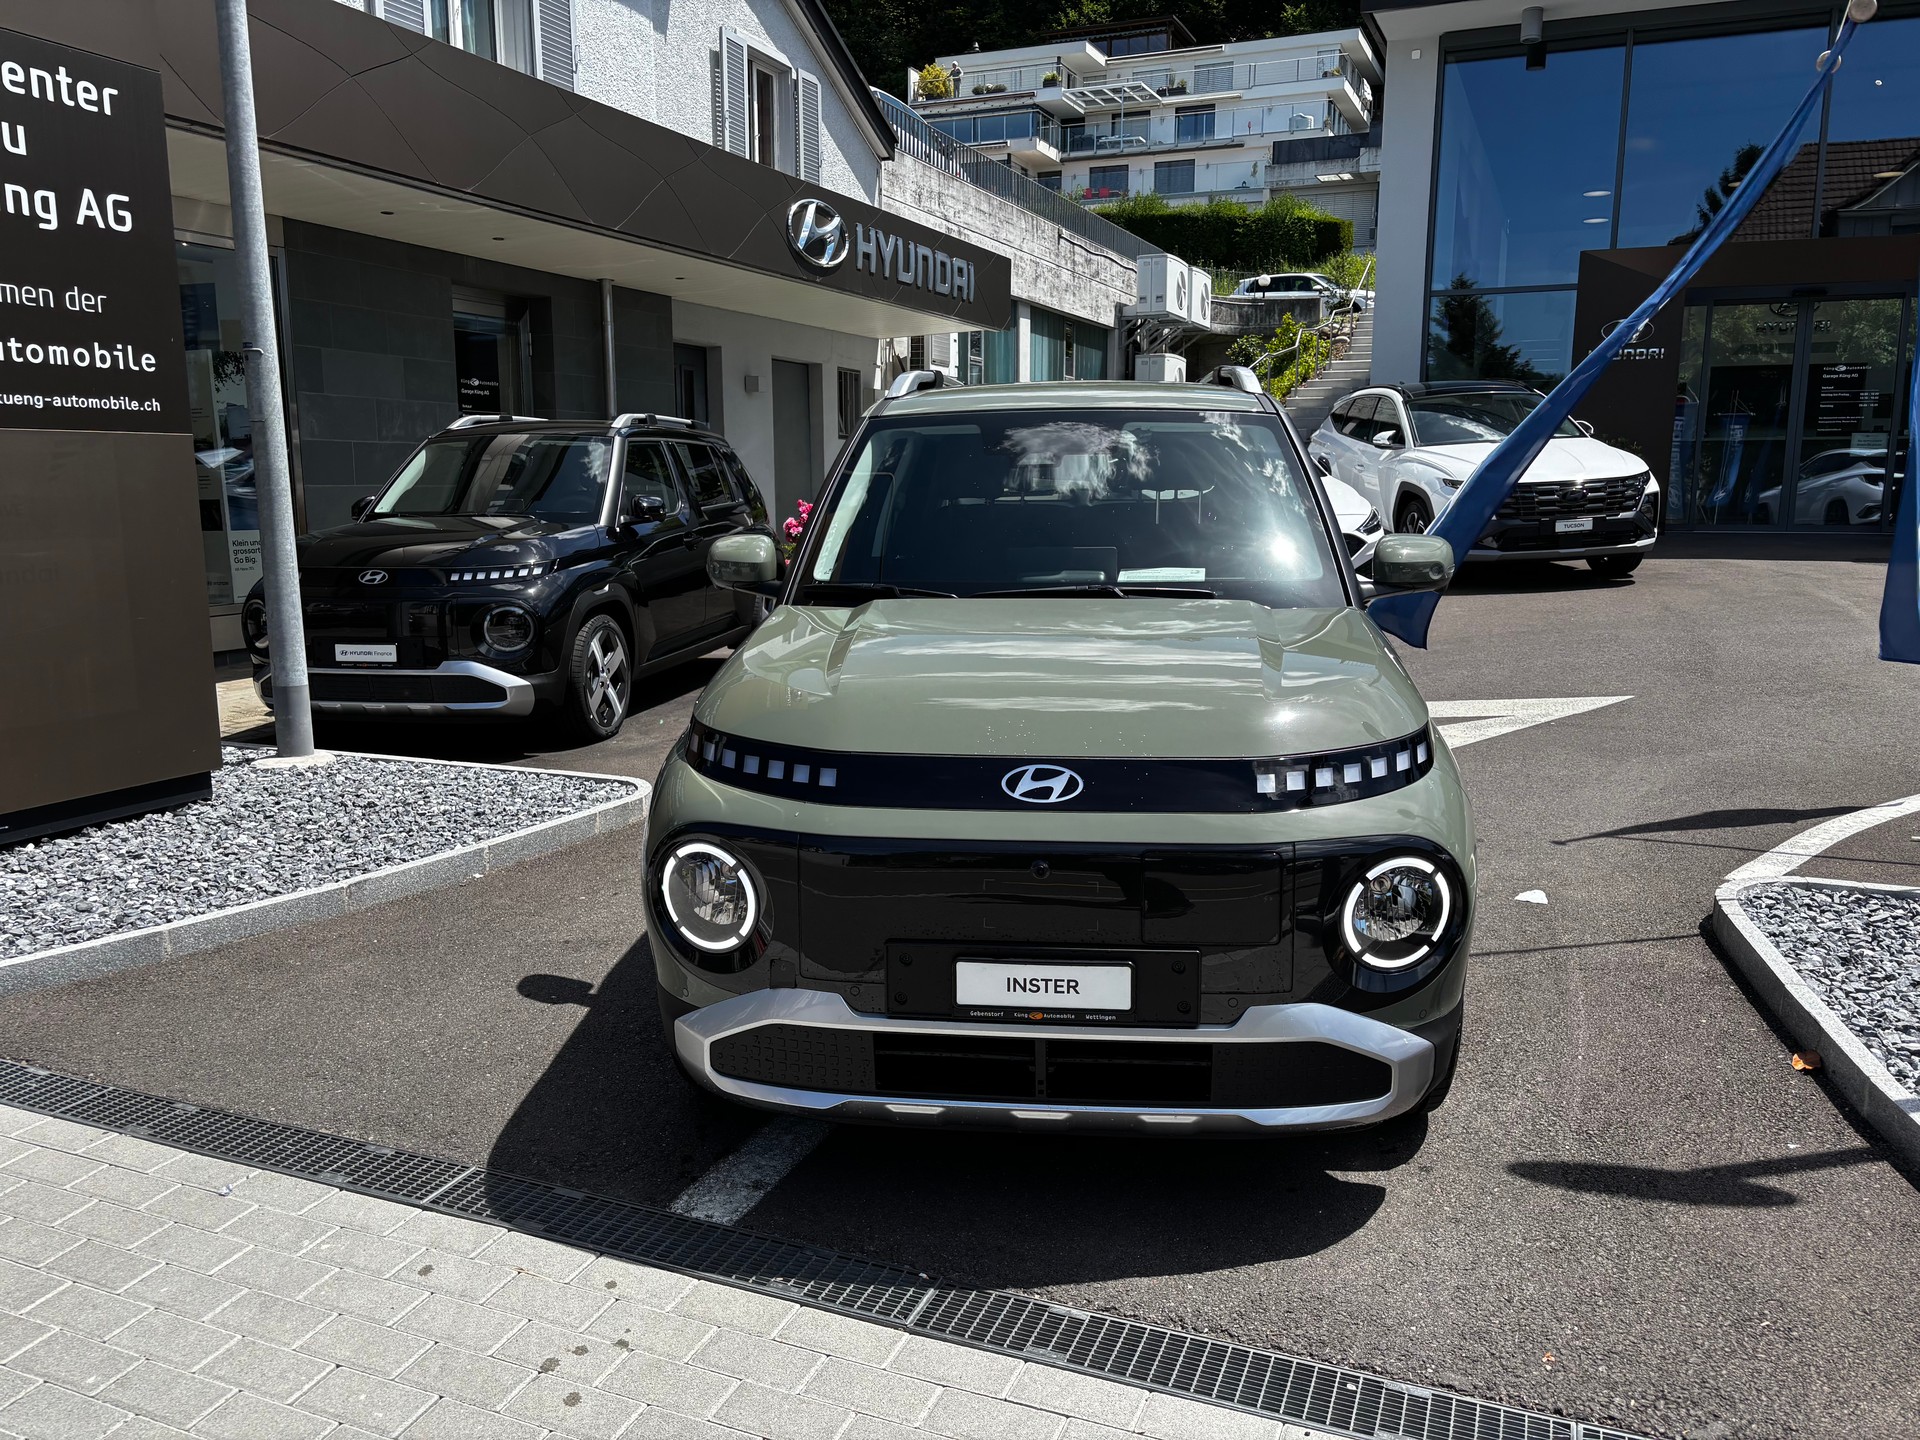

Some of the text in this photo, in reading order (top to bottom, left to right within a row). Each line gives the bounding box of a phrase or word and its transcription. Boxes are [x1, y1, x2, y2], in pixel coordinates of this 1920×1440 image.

[1, 61, 119, 116] enter
[1, 121, 27, 156] u
[4, 183, 133, 233] ng AG
[855, 222, 975, 303] HYUNDAI
[65, 286, 107, 313] der
[1007, 977, 1080, 995] INSTER
